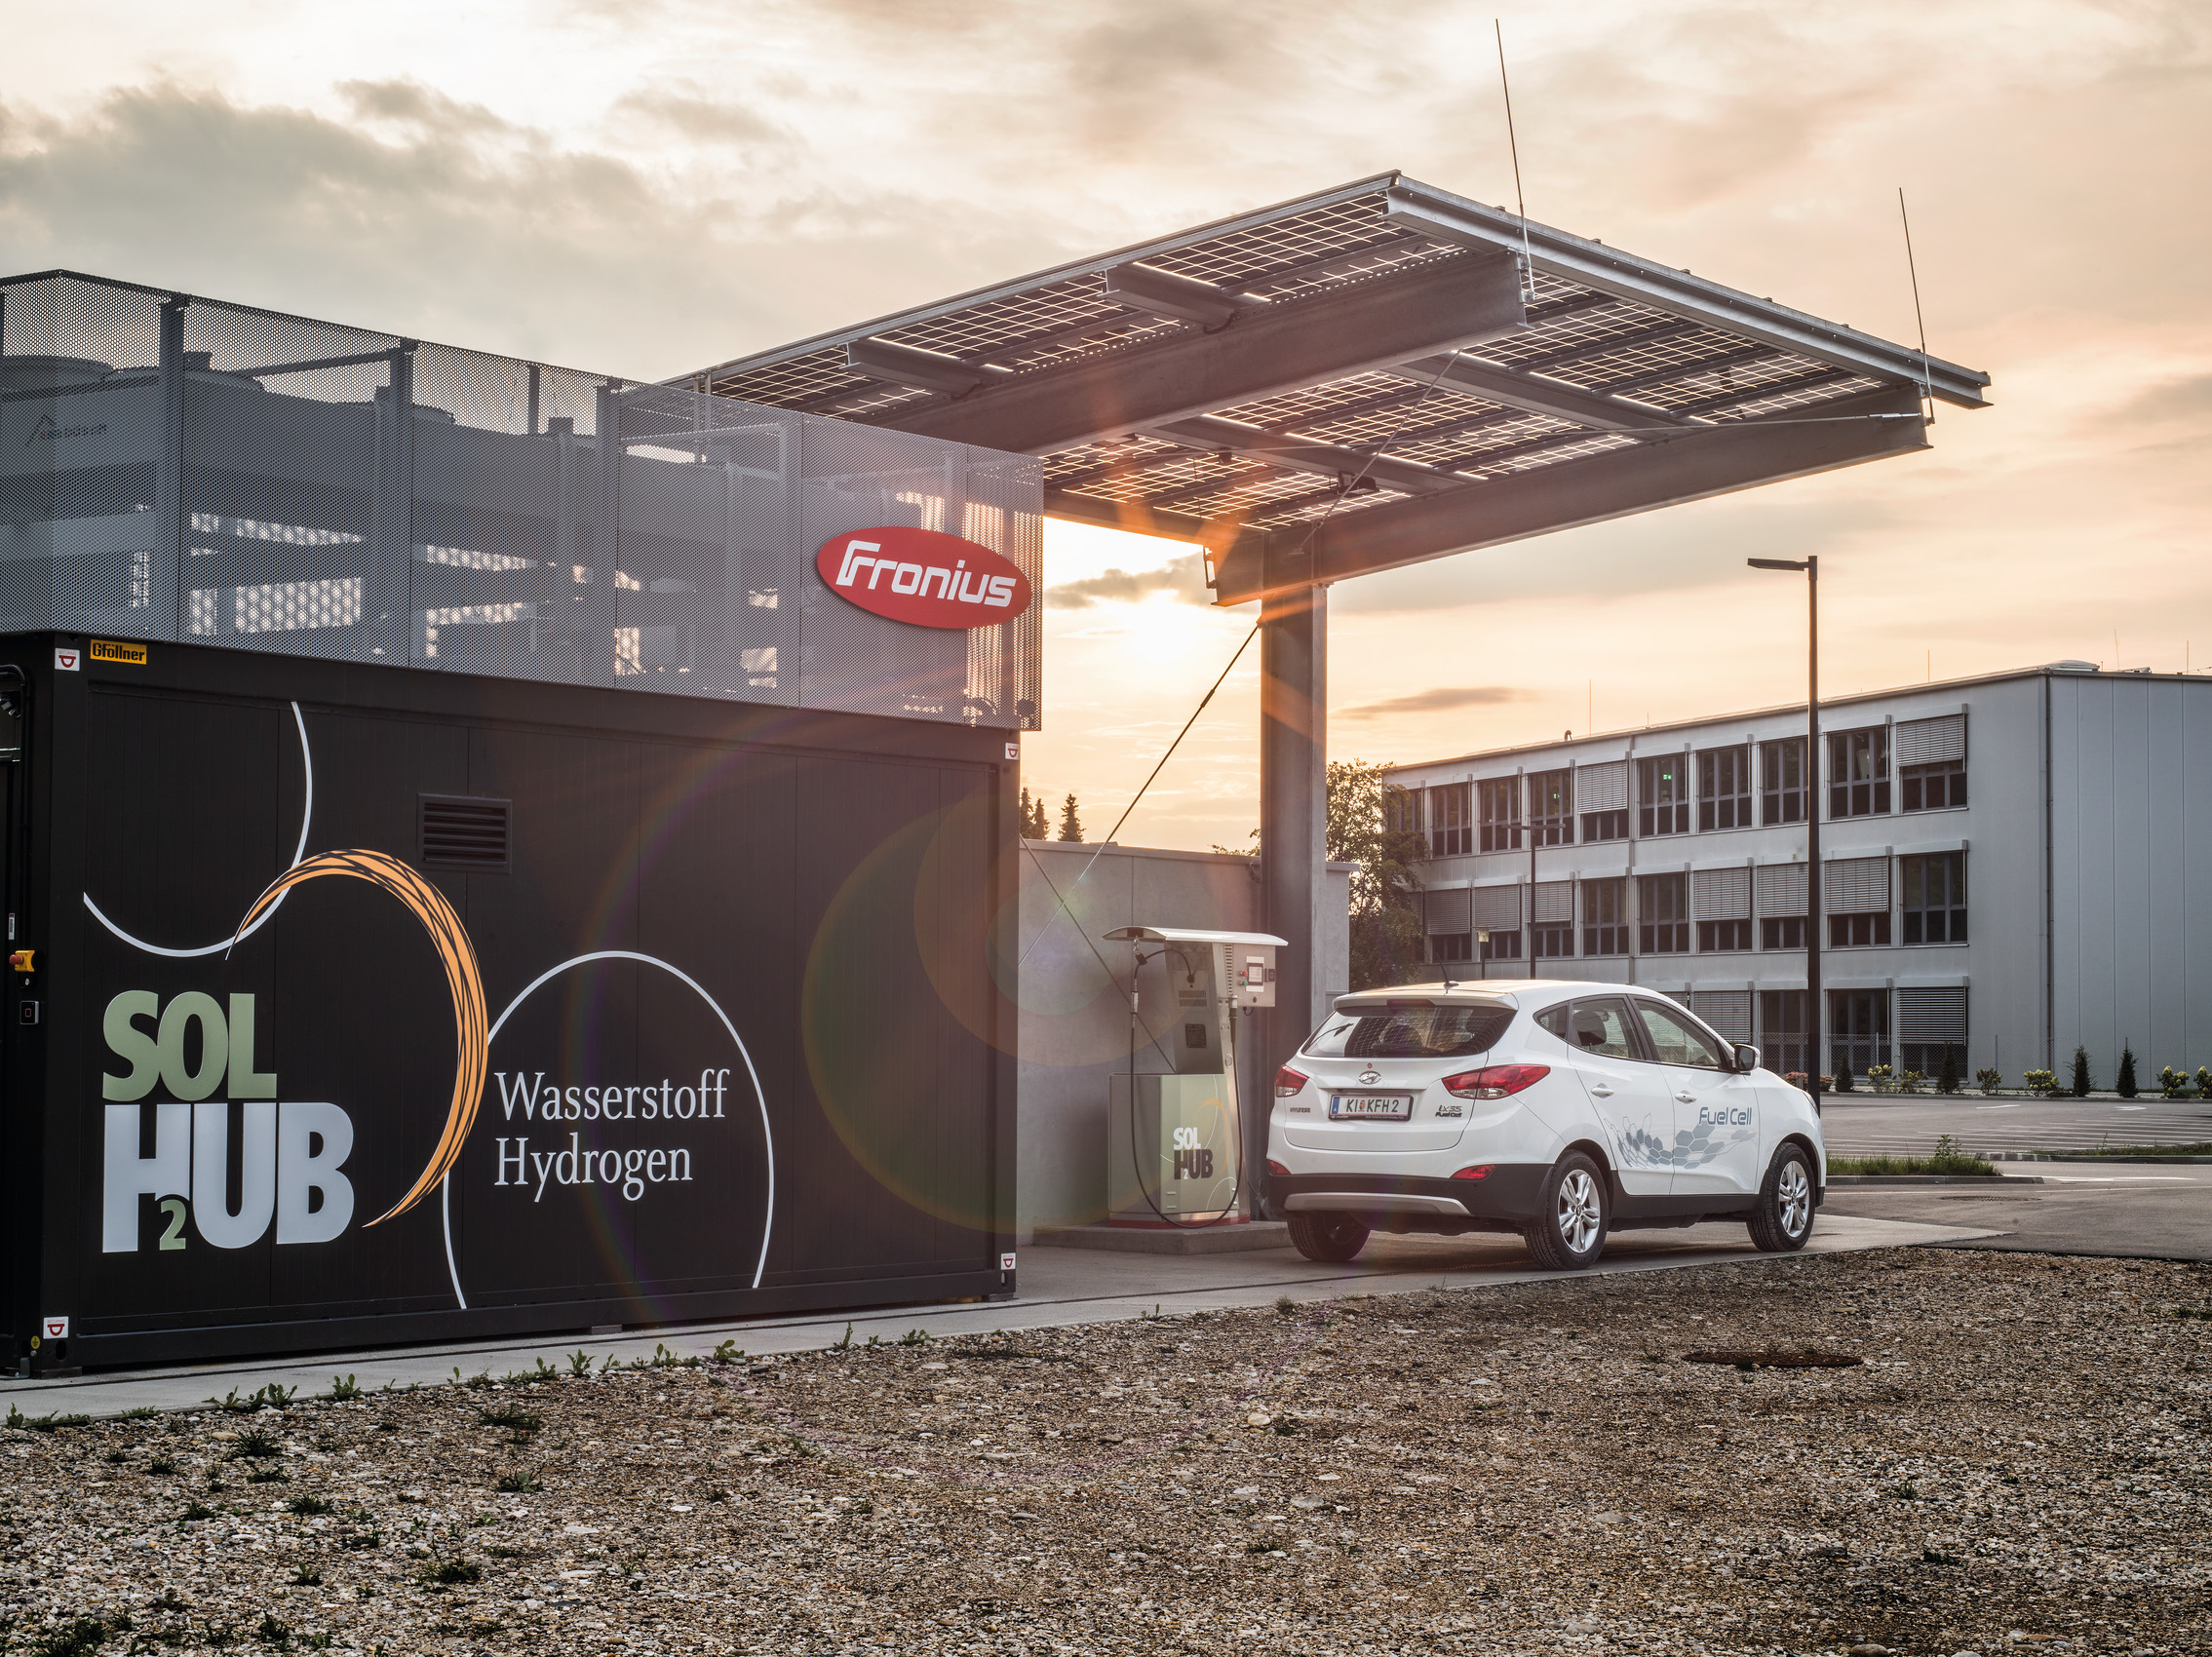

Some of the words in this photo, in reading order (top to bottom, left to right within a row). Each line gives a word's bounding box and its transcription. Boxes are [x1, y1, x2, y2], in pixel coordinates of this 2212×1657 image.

[835, 539, 1017, 608] Fronius
[93, 643, 144, 661] Gföllner
[102, 989, 277, 1101] SOL
[493, 1068, 730, 1120] Wasserstoff
[1345, 1098, 1358, 1113] KI
[1366, 1098, 1389, 1113] KFH
[1391, 1098, 1400, 1113] 2
[1699, 1106, 1728, 1126] Fuel
[1730, 1106, 1752, 1126] Cell
[1173, 1127, 1202, 1150] SOL
[493, 1132, 693, 1203] Hydrogen
